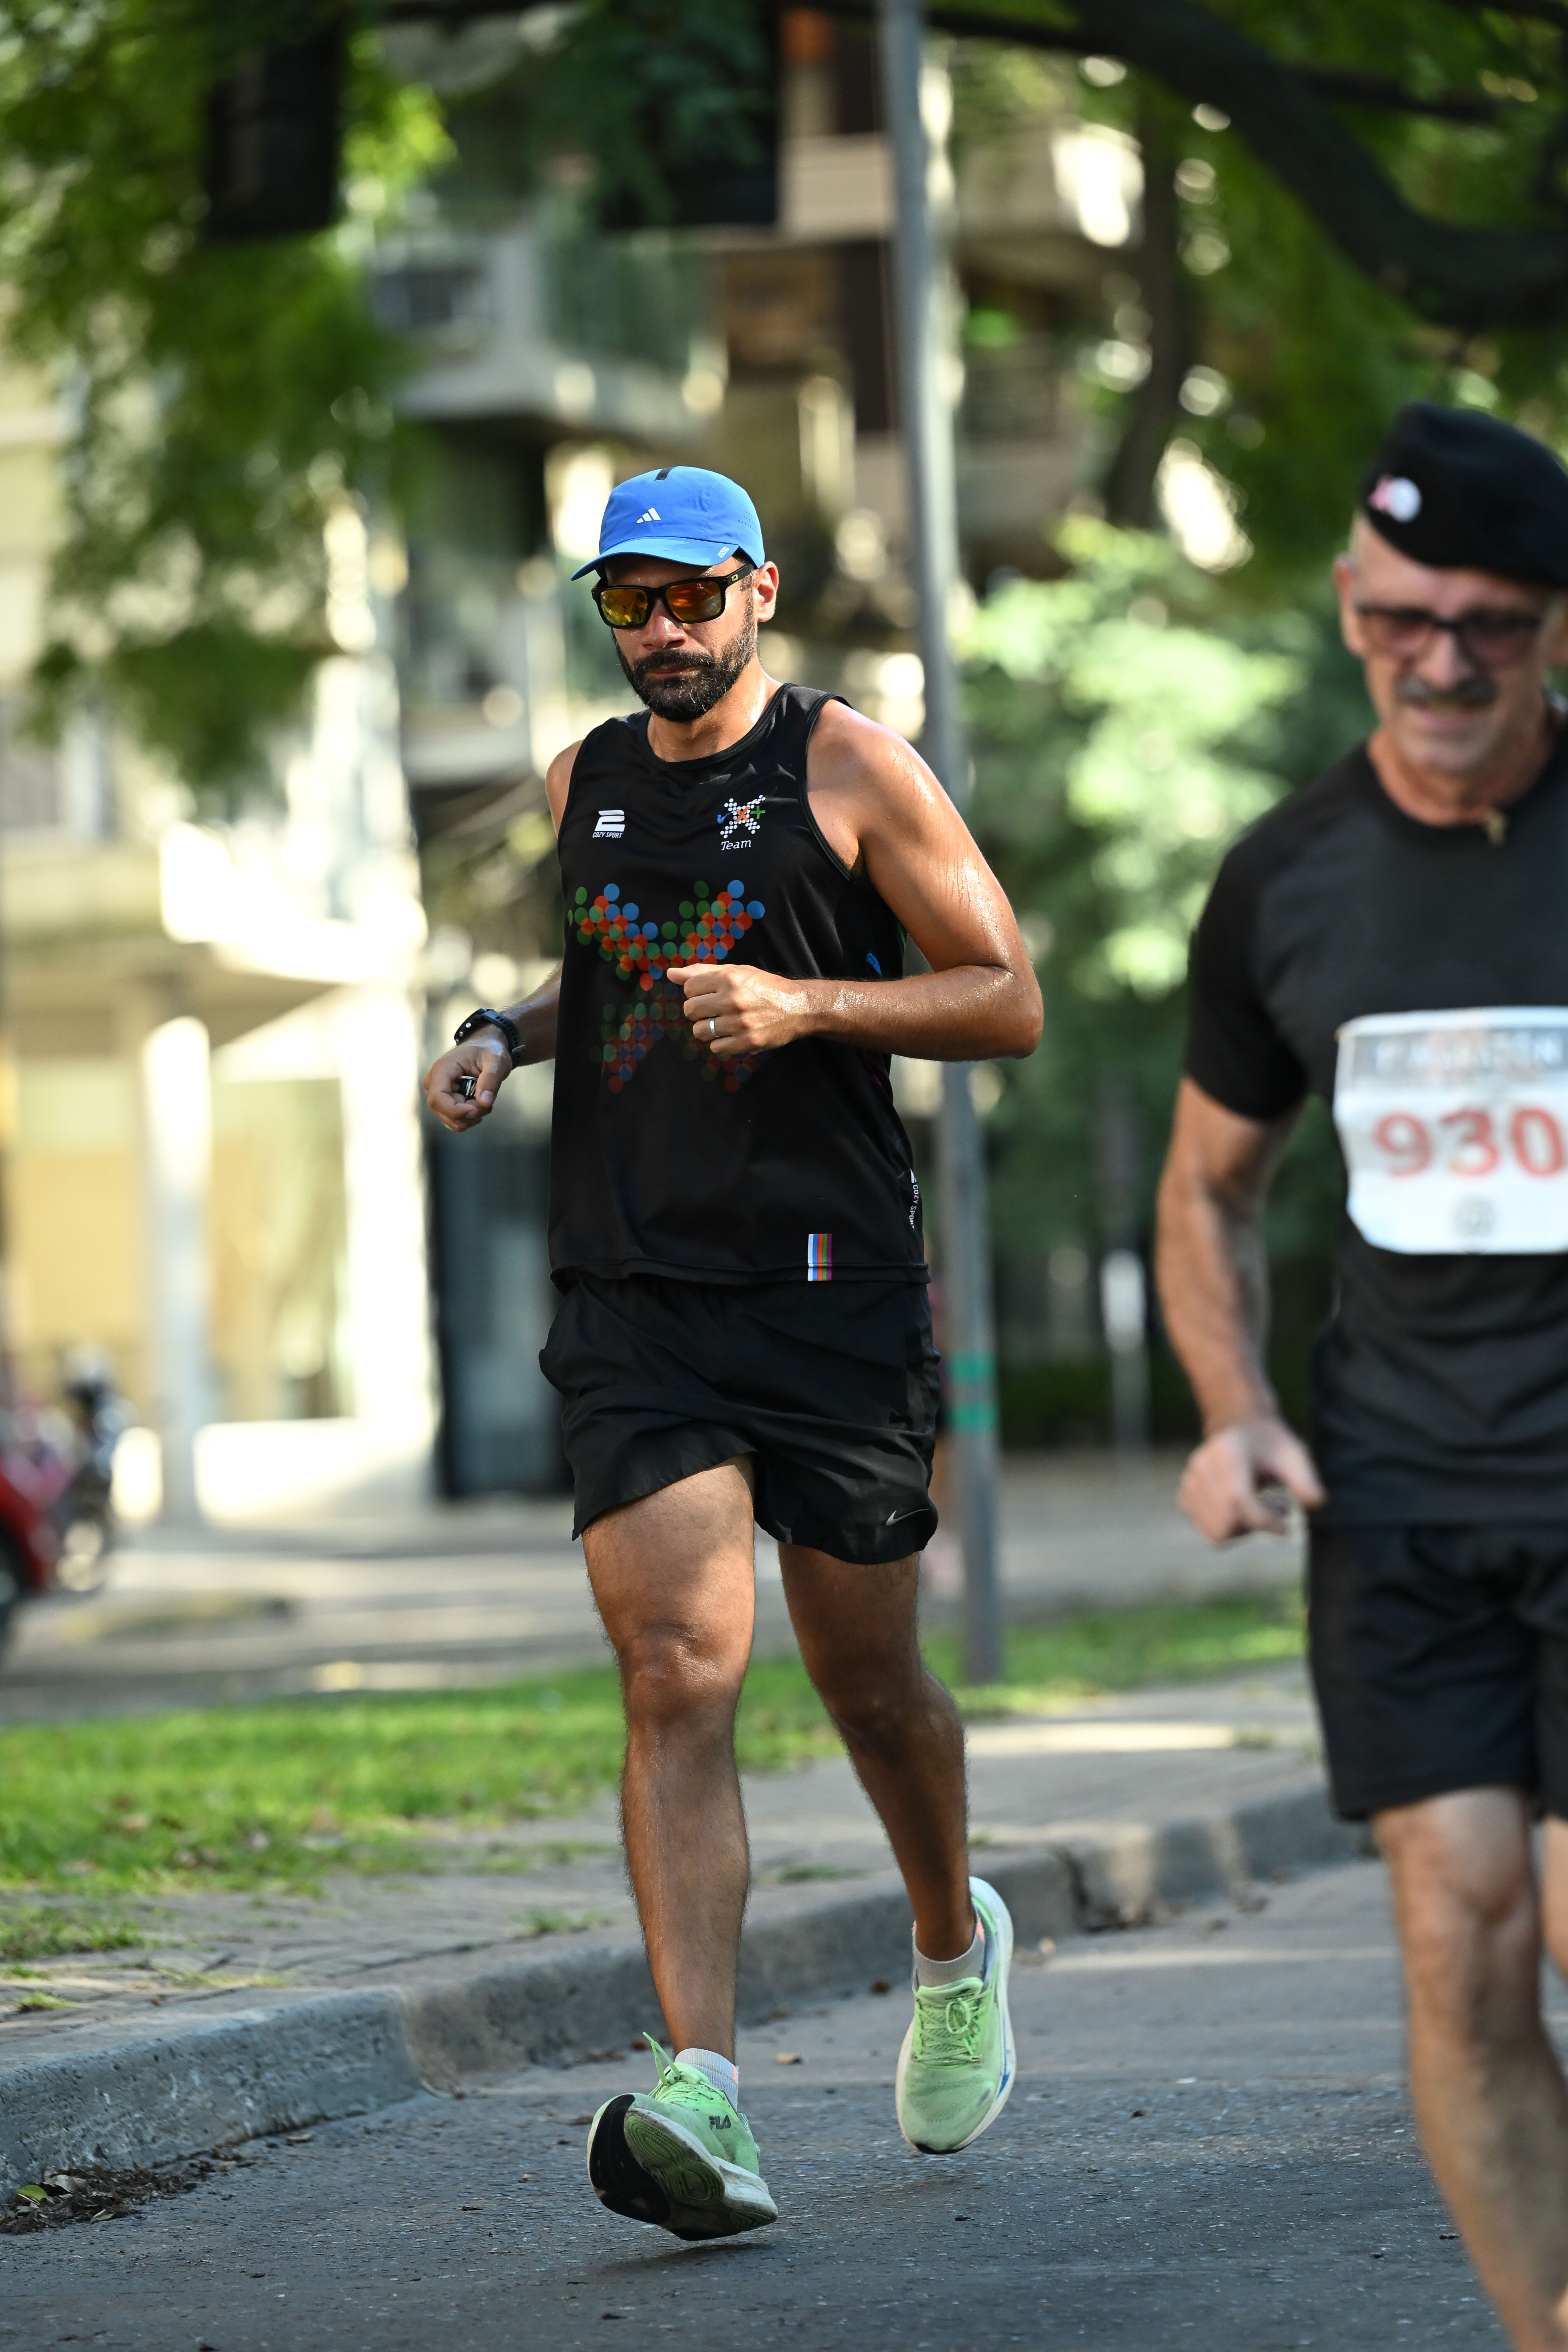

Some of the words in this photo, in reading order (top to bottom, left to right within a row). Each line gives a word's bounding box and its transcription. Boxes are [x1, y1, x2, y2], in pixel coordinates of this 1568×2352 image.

[721, 840, 752, 851] Team
[1373, 1107, 1566, 1178] 930
[709, 2115, 731, 2130] FILA
